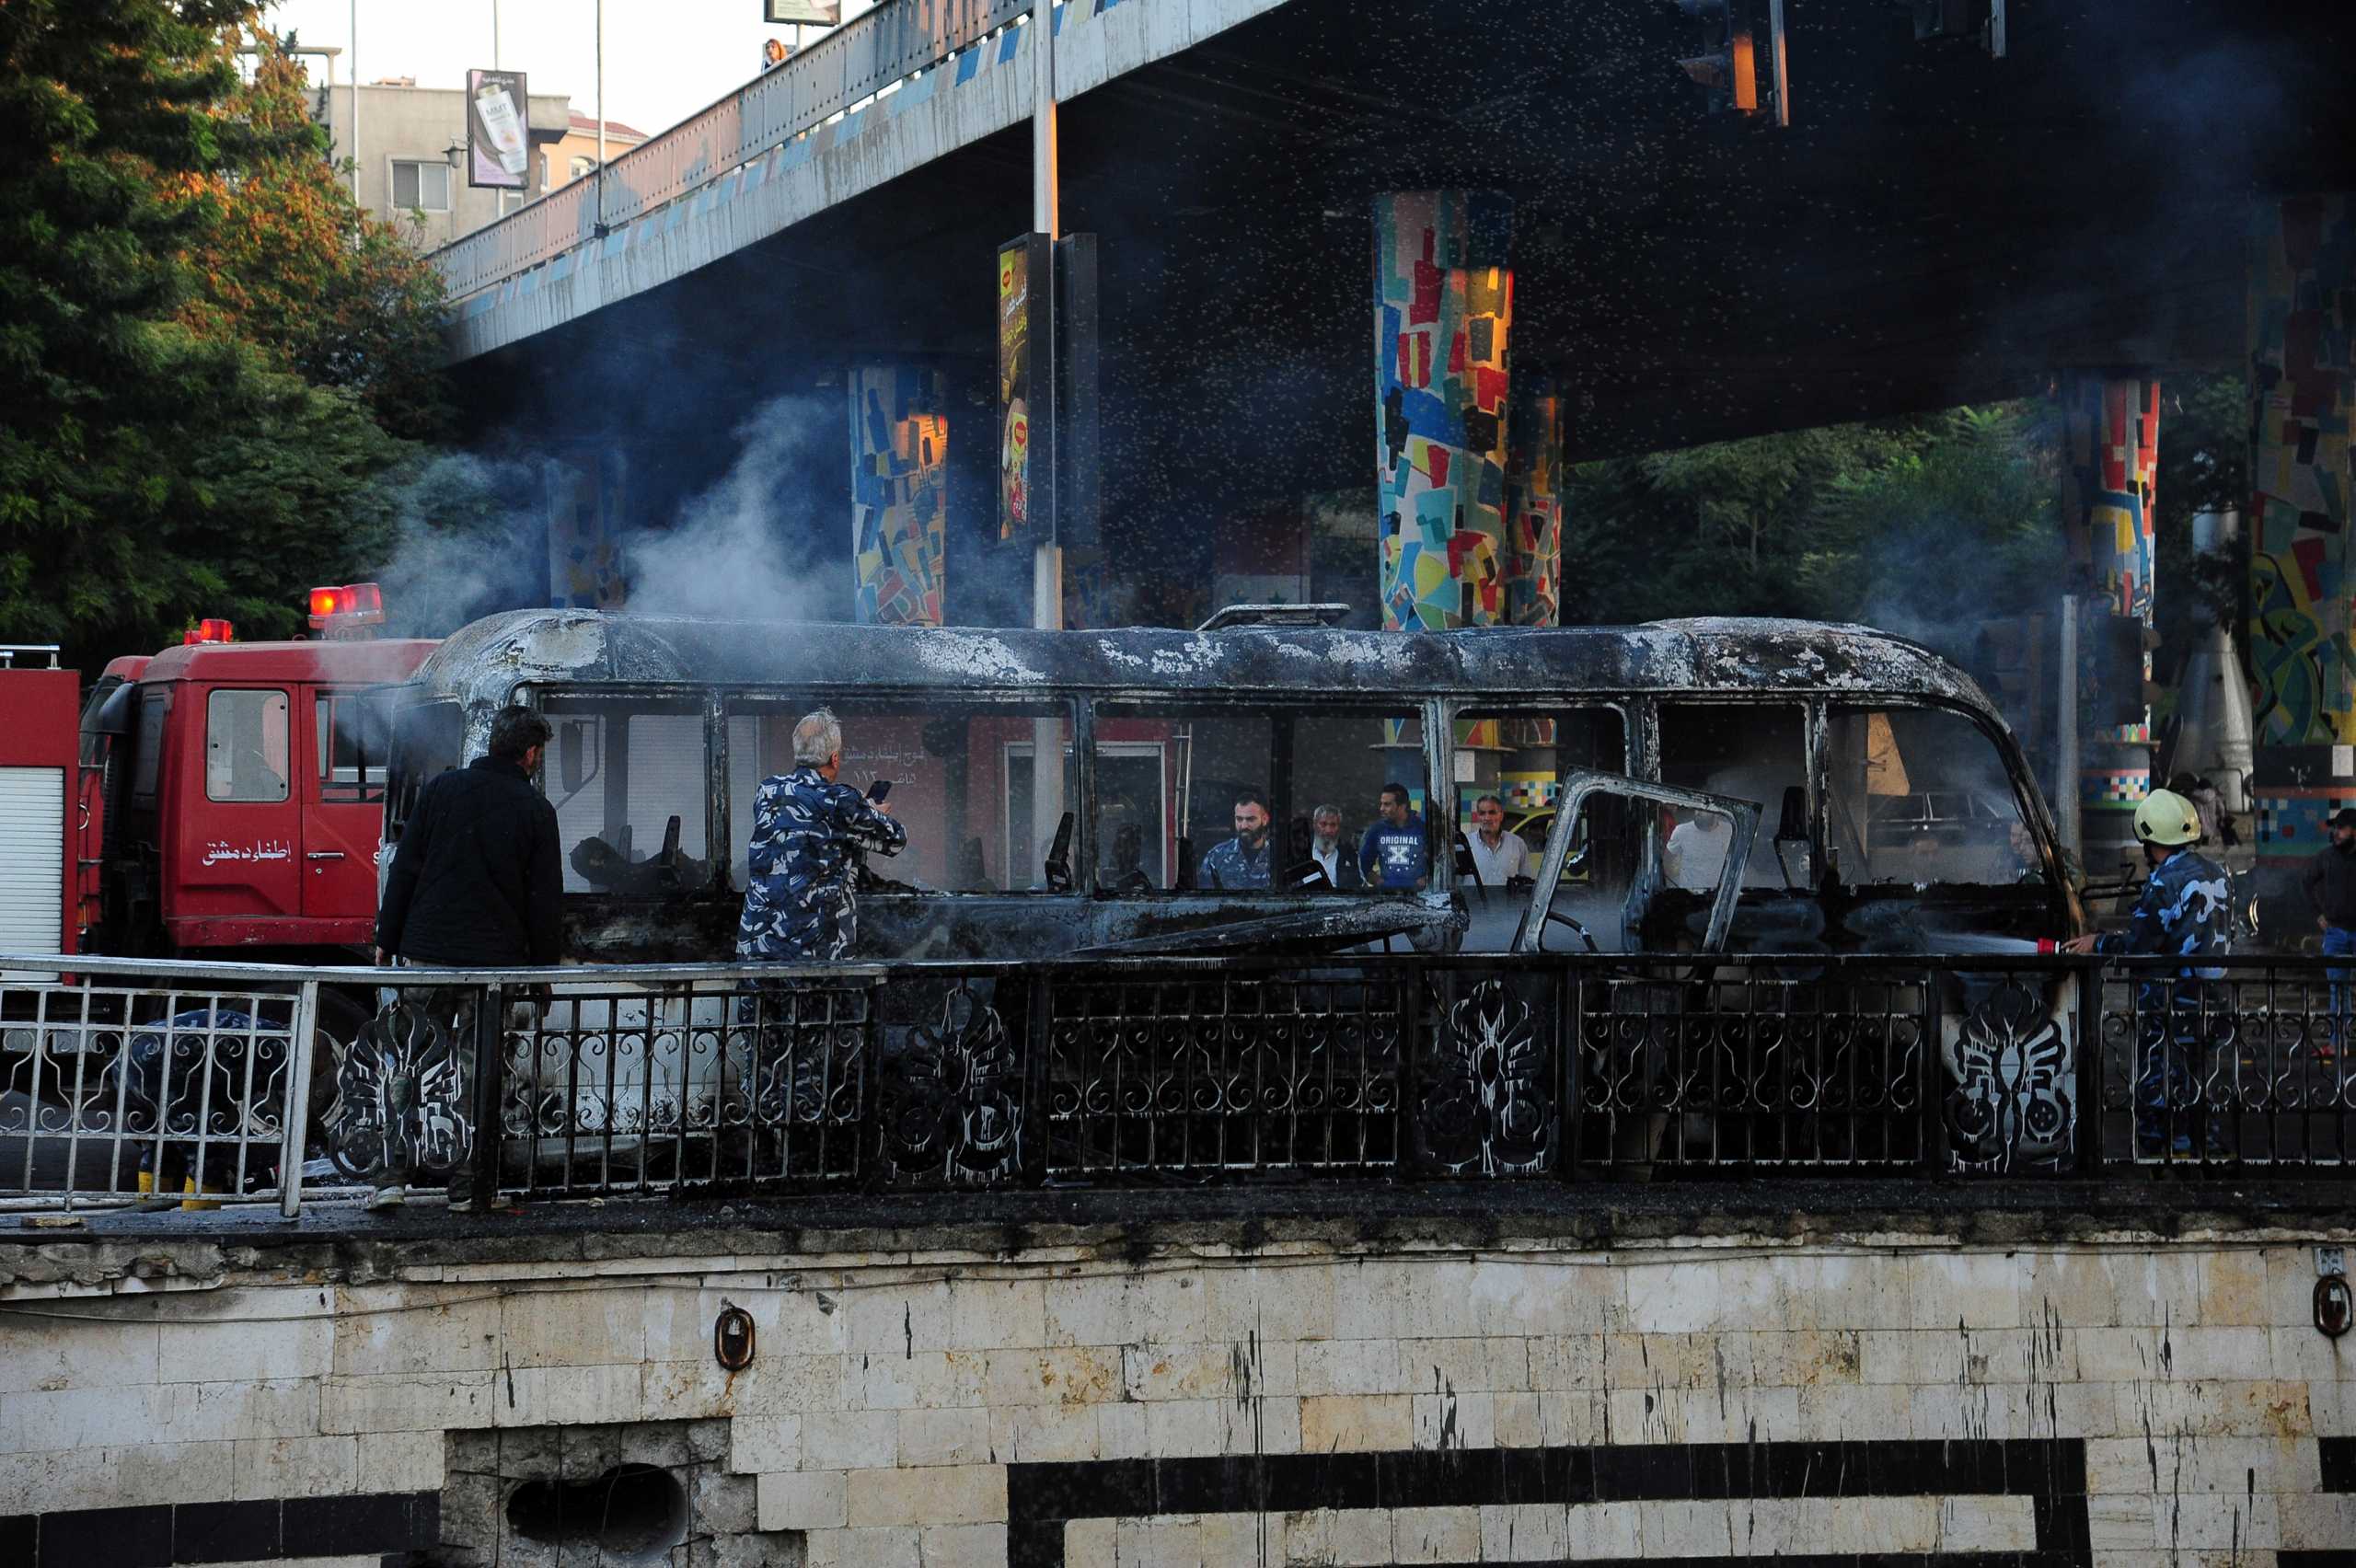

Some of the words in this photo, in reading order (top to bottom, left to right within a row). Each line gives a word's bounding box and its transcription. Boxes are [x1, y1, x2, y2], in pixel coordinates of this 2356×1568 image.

[251, 839, 291, 862] إطفاء
[1380, 836, 1418, 846] ORIGINAL
[202, 840, 251, 866] دمشق
[1388, 845, 1410, 865] X
